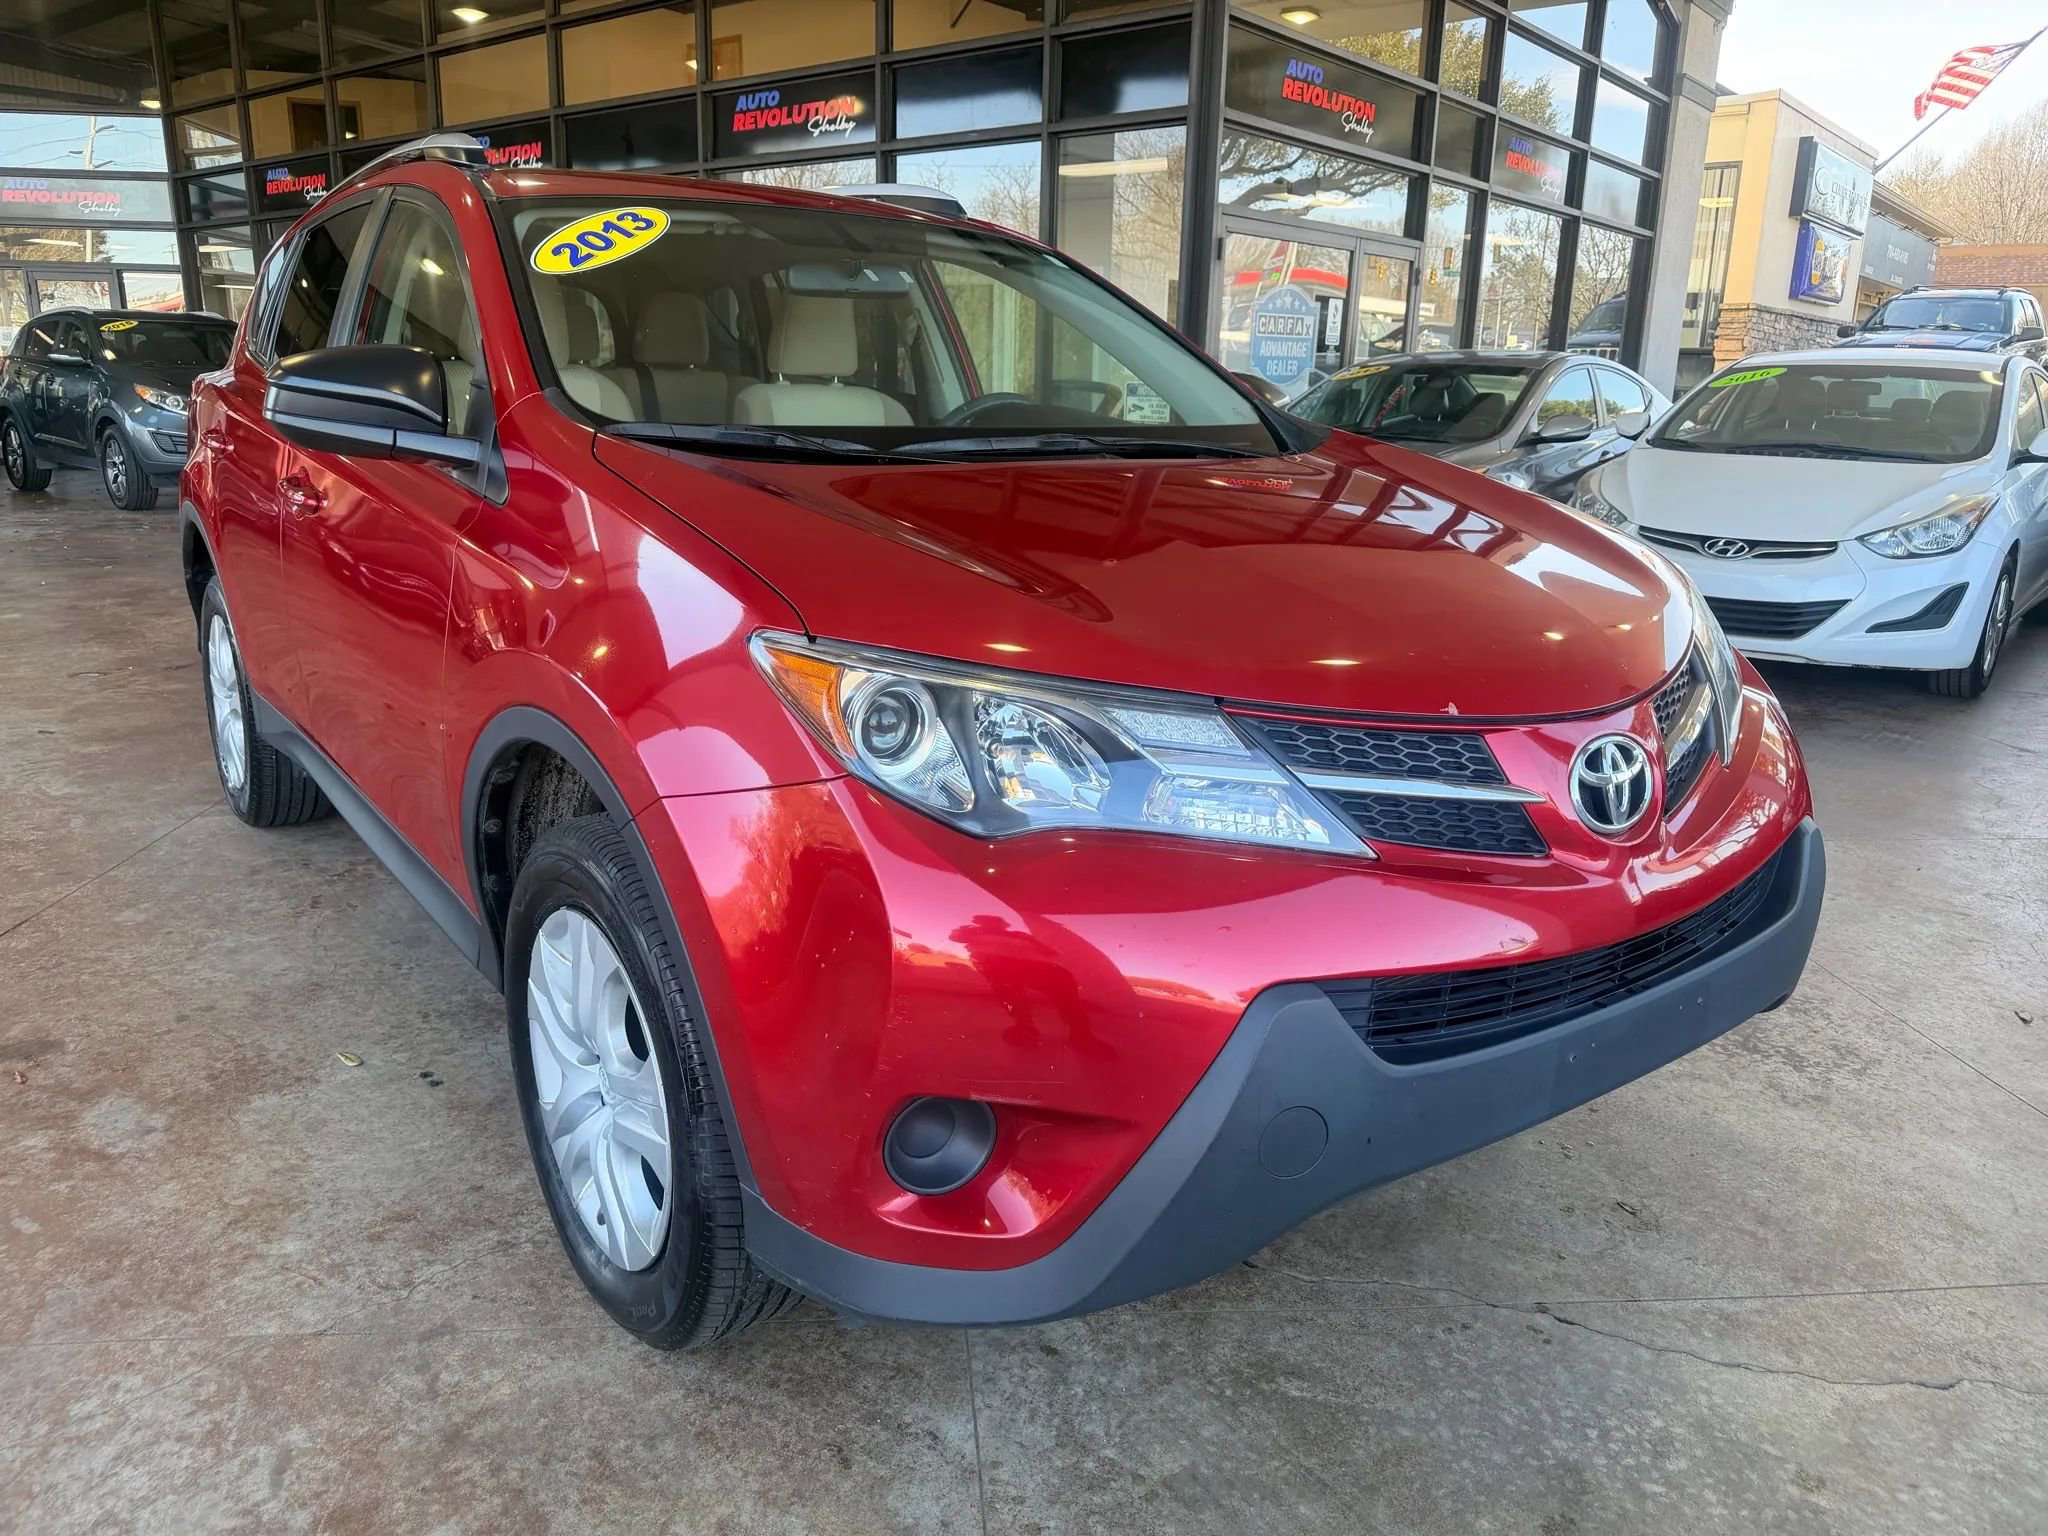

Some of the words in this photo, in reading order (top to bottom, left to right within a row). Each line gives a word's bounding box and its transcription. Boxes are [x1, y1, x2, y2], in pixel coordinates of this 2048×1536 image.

[1286, 59, 1324, 84] AUTO
[736, 90, 780, 111] AUTO
[1282, 77, 1376, 122] REVOLUTION
[733, 96, 856, 132] REVOLUTION
[808, 111, 856, 138] Shelby
[1341, 111, 1374, 144] Shelby
[484, 141, 542, 165] OLUTION
[1508, 136, 1533, 155] AUTO
[267, 167, 289, 181] AUTO
[267, 174, 326, 195] REVOLUTION
[4, 180, 49, 190] AUTO
[1, 190, 121, 204] REVOLUTION
[78, 201, 122, 217] Shelby
[551, 211, 658, 268] 2013
[1258, 314, 1313, 337] CARFAX
[1259, 340, 1308, 358] ADVANTAGE
[1266, 359, 1298, 376] DEALER
